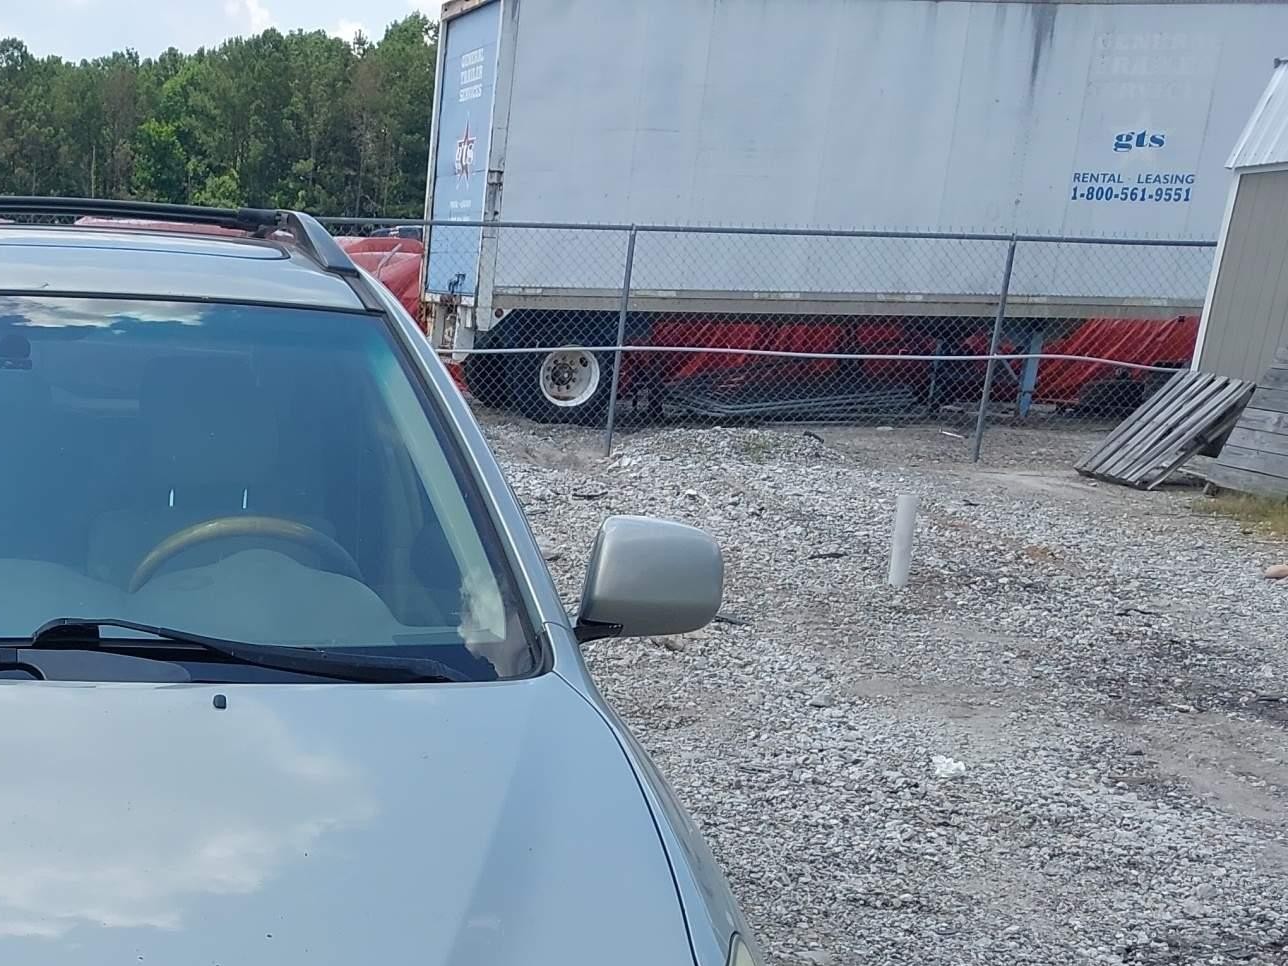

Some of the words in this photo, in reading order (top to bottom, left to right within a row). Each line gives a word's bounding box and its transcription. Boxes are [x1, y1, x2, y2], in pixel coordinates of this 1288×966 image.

[1113, 130, 1165, 152] gts
[1073, 172, 1124, 184] RENTAL
[1137, 173, 1195, 185] LEASING
[1072, 186, 1192, 202] 1-800-561-9551
